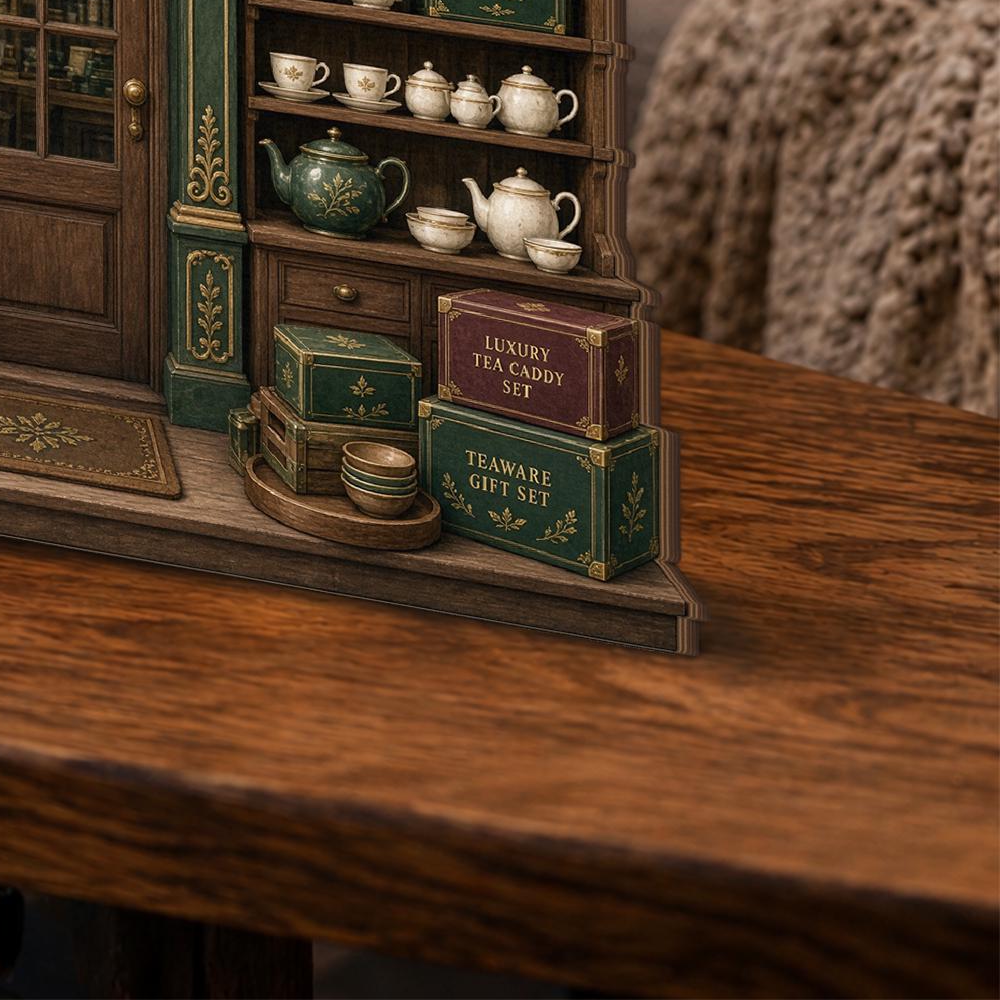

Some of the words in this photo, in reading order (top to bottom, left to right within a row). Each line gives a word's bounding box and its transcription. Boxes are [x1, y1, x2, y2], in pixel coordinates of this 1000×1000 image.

[484, 335, 550, 362] LUXURY
[472, 352, 505, 373] TEA
[509, 361, 565, 387] CADDY
[503, 379, 533, 400] SET
[465, 449, 552, 487] TEAWARE
[468, 474, 510, 498] GIFT
[517, 485, 551, 508] SET
